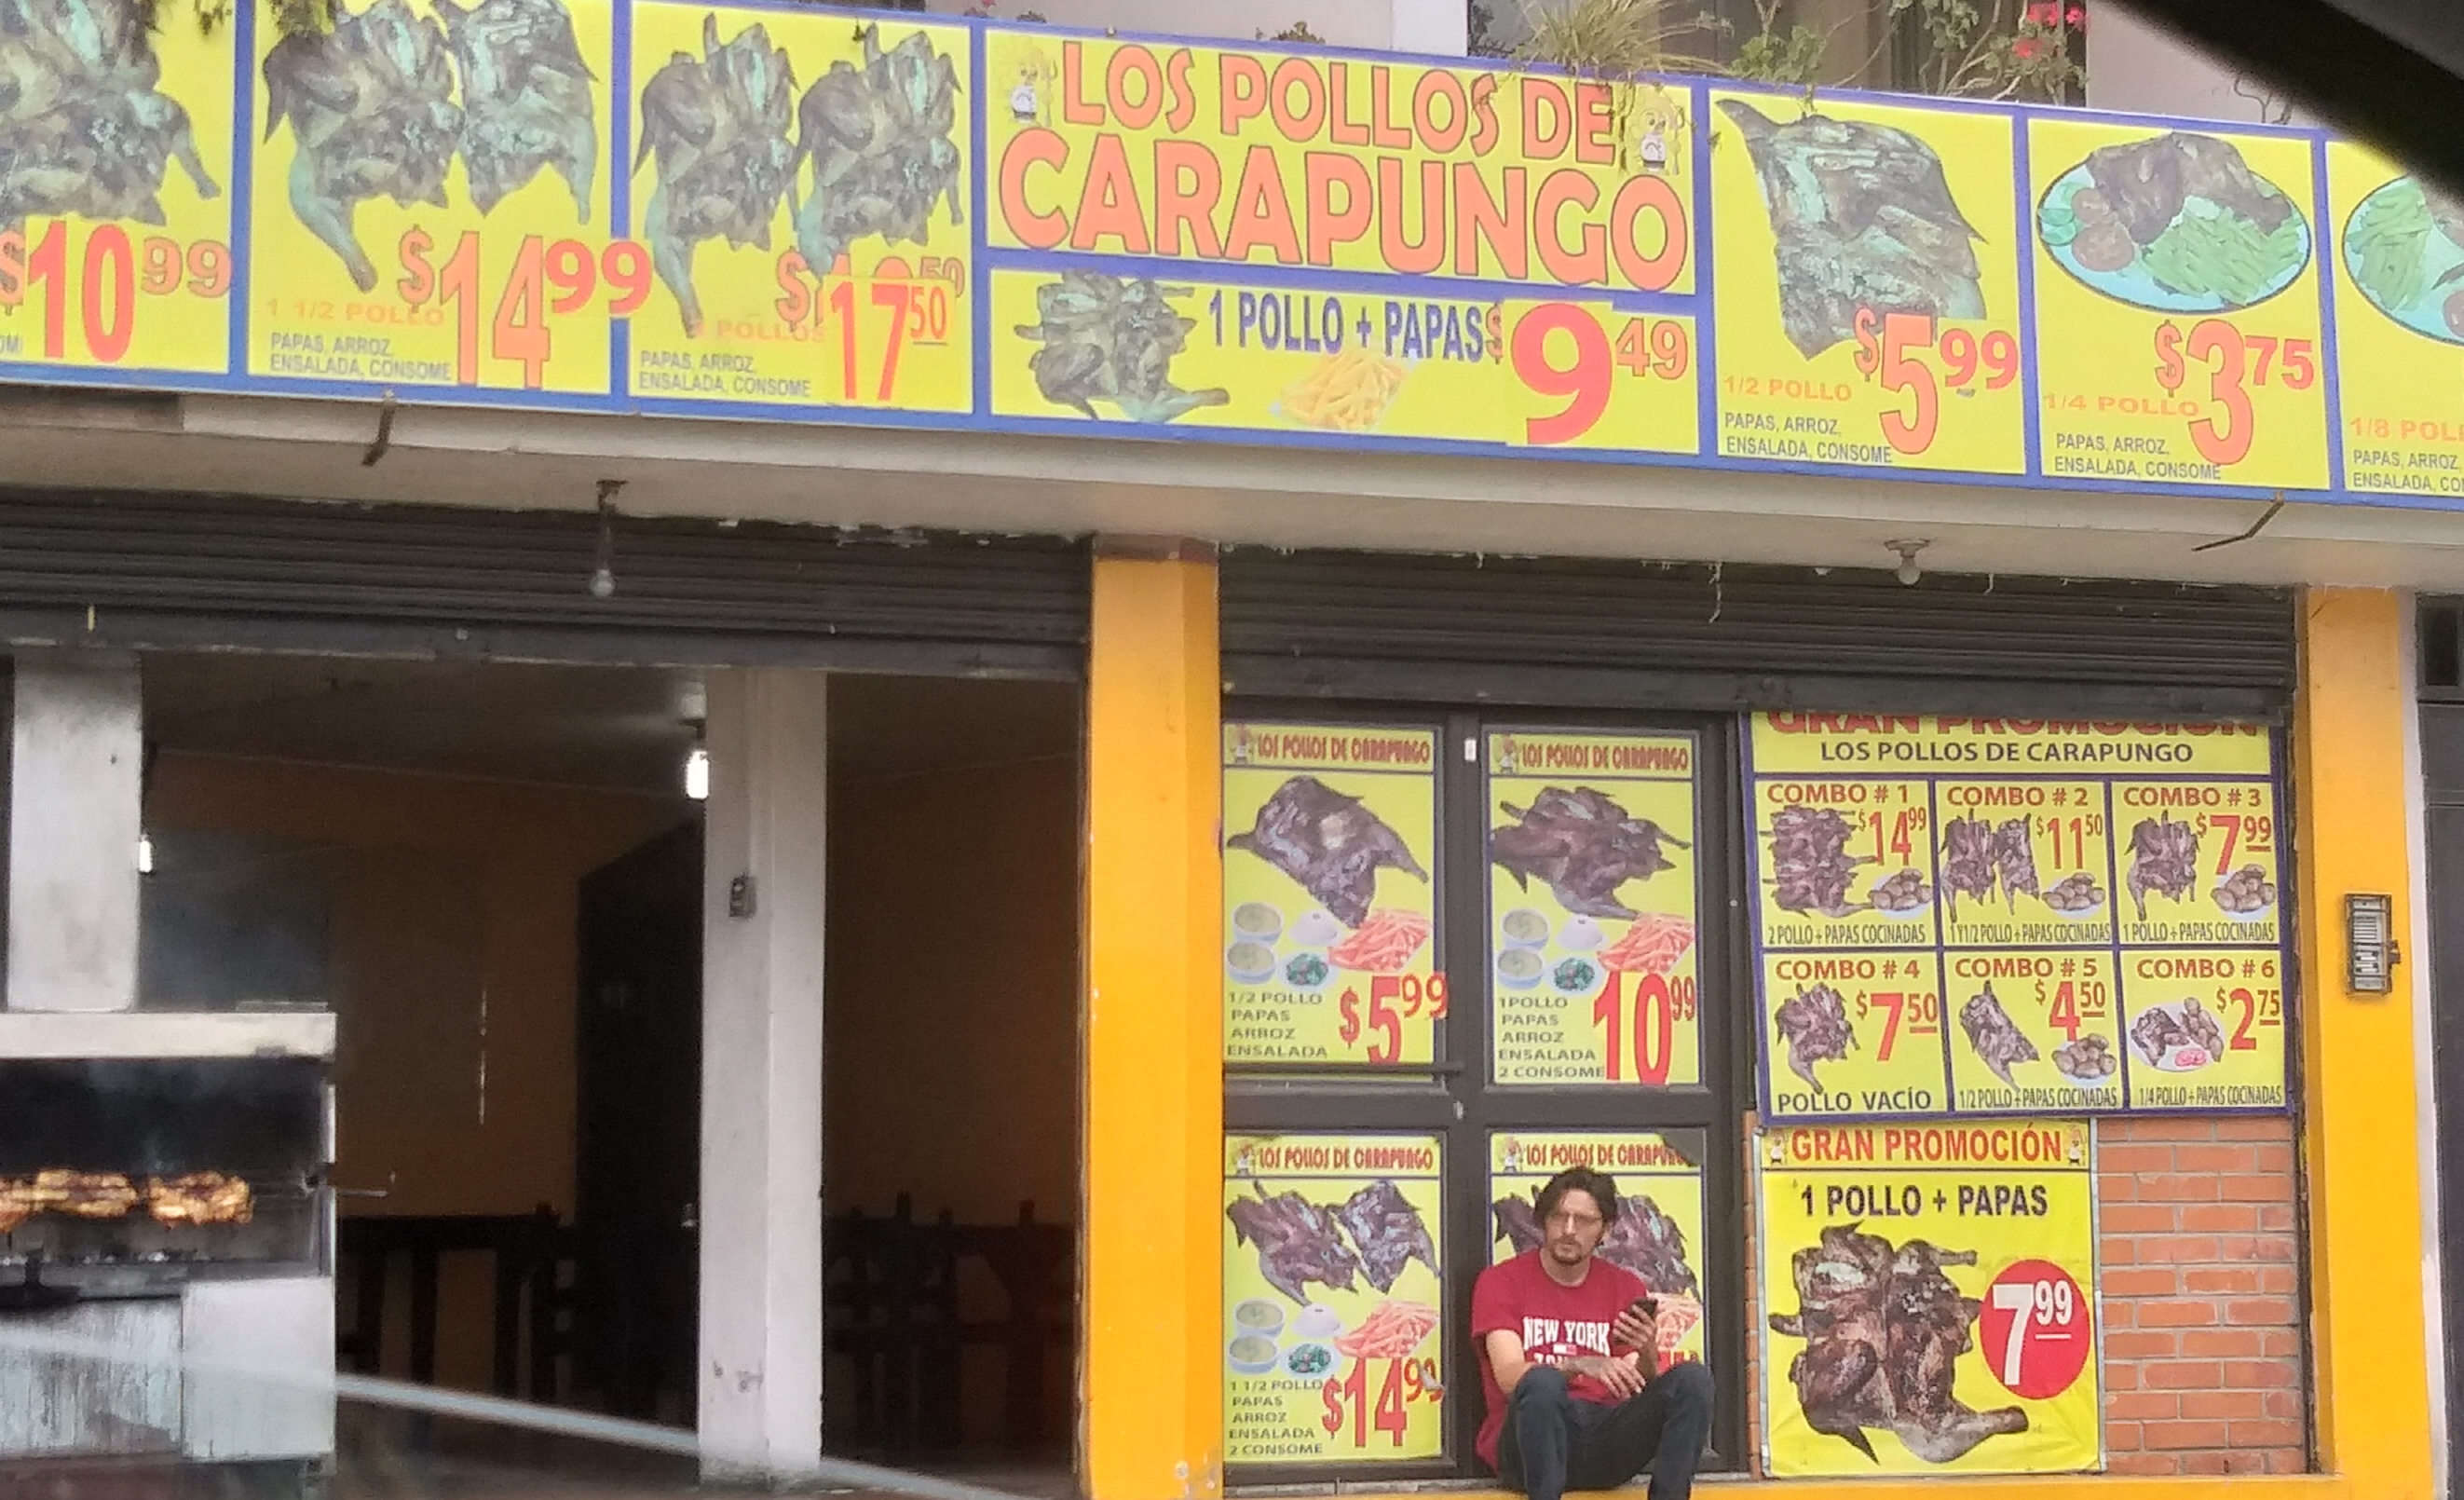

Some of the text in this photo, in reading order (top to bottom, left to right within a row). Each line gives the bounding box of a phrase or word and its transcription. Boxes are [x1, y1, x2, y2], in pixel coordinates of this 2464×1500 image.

[1063, 41, 1614, 164] LOS POLLOS DE
[999, 128, 1688, 292] CARAPUNGO
[266, 298, 443, 325] 1 1/2 POLLO
[1209, 291, 1222, 347] 1
[1239, 293, 1343, 354] POLLO
[1356, 307, 1371, 348] +
[1384, 301, 1484, 363] PAPAS
[370, 359, 452, 380] CONSOME
[733, 376, 810, 397] CONSOME
[1724, 376, 1852, 402] 1/2 POLLO
[2044, 394, 2200, 416] 1/4 POLLO
[2350, 417, 2389, 438] 1/8
[1817, 442, 1893, 463] CONSOME
[2145, 463, 2222, 481] CONSOME
[2440, 476, 2464, 493] CO
[1821, 743, 2194, 763] LOS POLLOS DE CARAPUNGO
[1767, 784, 1867, 803] COMBO
[1898, 784, 1908, 803] 1
[1947, 786, 2045, 806] COMBO
[2075, 786, 2088, 806] 2
[2123, 786, 2221, 806] COMBO
[2248, 787, 2261, 806] 3
[1769, 924, 1775, 944] 2
[1777, 924, 1813, 944] POLLO
[1825, 923, 1858, 943] PAPAS
[1862, 923, 1926, 943] COCINADAS
[2123, 923, 2129, 942] 1
[2132, 923, 2168, 942] POLLO
[2180, 922, 2213, 941] PAPAS
[2215, 922, 2275, 941] COCINADAS
[1776, 960, 1875, 980] COMBO
[1904, 960, 1920, 979] 4
[1956, 958, 2053, 978] COMBO
[2083, 958, 2097, 977] 5
[2136, 959, 2235, 978] COMBO
[2261, 959, 2275, 978] 6
[1228, 991, 1323, 1005] 1/2 POLLO
[1232, 1009, 1291, 1022] PAPAS
[1502, 1014, 1559, 1026] PAPAS
[1232, 1027, 1296, 1040] ARROZ
[1502, 1031, 1564, 1043] ARROZ
[1227, 1044, 1328, 1058] ENSALADA
[1498, 1049, 1596, 1061] ENSALADA
[1498, 1066, 1604, 1079] 2 CONSOME
[1777, 1087, 1931, 1112] POLLO VACÍO
[1960, 1090, 1976, 1109] 1/2
[1979, 1089, 2012, 1108] POLLO
[2022, 1088, 2055, 1107] PAPAS
[2057, 1087, 2117, 1106] COCINADAS
[2140, 1087, 2154, 1106] 1/4
[2157, 1086, 2186, 1105] POLLO
[2197, 1086, 2226, 1105] PAPAS
[2227, 1085, 2281, 1104] COCINADAS
[1792, 1122, 2062, 1162] GRAN PROMOCIÓN
[1802, 1184, 2048, 1216] 1 POLLO + PAPAS
[1523, 1316, 1611, 1357] NEW YORK
[1230, 1380, 1324, 1391] 1 1/2 POLLO
[1232, 1396, 1283, 1407] PAPAS
[1232, 1411, 1287, 1424] ARROZ
[1229, 1427, 1315, 1439] ENSALADA
[1230, 1443, 1323, 1455] 2 CONSOME
